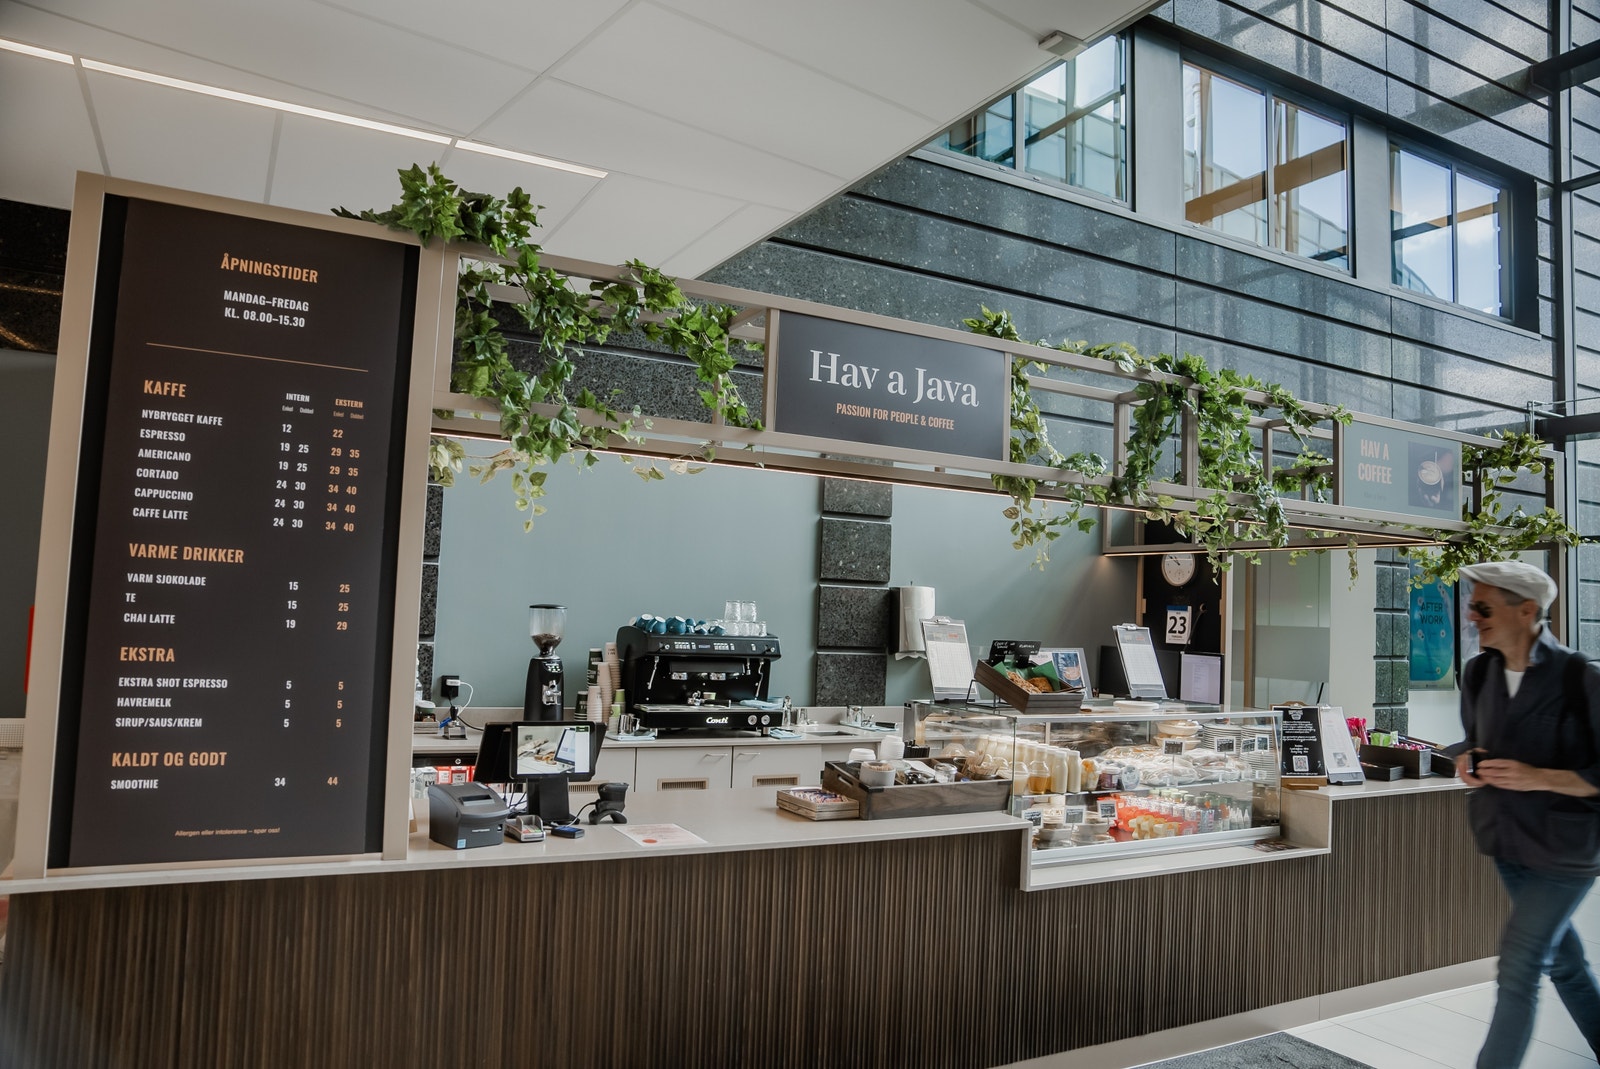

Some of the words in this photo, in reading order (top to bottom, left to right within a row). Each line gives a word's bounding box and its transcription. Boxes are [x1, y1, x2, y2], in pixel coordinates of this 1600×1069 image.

[221, 253, 318, 283] ÅPNINGSTIDER
[225, 307, 239, 318] KL.
[809, 350, 879, 389] Hav
[888, 371, 907, 395] a
[913, 368, 979, 407] Java
[144, 380, 186, 397] KAFFE
[286, 393, 309, 402] INTERN
[336, 399, 363, 408] EKSTERN
[142, 409, 194, 422] NYBRYGGET
[197, 415, 222, 426] KAFFE
[282, 424, 292, 433] 12
[333, 429, 343, 438] 22
[837, 403, 870, 417] PASSION
[873, 408, 888, 420] FOR
[891, 411, 919, 424] PEOPLE
[921, 416, 926, 425] &
[929, 417, 954, 430] COFFEE
[140, 429, 185, 441] ESPRESSO
[281, 443, 290, 451] 19
[299, 444, 309, 453] 25
[331, 448, 341, 456] 29
[350, 449, 359, 458] 35
[1361, 439, 1380, 458] HAV
[1382, 443, 1389, 460] A
[138, 449, 191, 461] AMERICANO
[279, 461, 288, 470] 19
[297, 463, 307, 472] 25
[330, 466, 340, 474] 29
[348, 468, 358, 476] 35
[137, 468, 178, 480] CORTADO
[277, 480, 287, 488] 24
[295, 482, 306, 490] 30
[328, 485, 338, 493] 34
[346, 486, 356, 494] 40
[1358, 463, 1392, 484] COFFEE
[135, 488, 193, 500] CAPPUCCINO
[275, 499, 285, 507] 24
[294, 500, 304, 509] 30
[327, 503, 337, 511] 34
[345, 505, 355, 513] 40
[133, 508, 160, 518] CAFFE
[163, 510, 188, 520] LATTE
[273, 518, 284, 526] 24
[292, 519, 303, 528] 30
[326, 522, 336, 530] 34
[344, 523, 354, 531] 40
[130, 543, 178, 559] VARME
[183, 547, 244, 563] DRIKKER
[128, 573, 153, 583] VARM
[156, 575, 206, 585] SJOKOLADE
[289, 582, 298, 590] 15
[340, 584, 349, 593] 25
[126, 593, 136, 602] TE
[288, 601, 297, 609] 15
[338, 603, 348, 611] 25
[1420, 602, 1443, 612] AFTER
[124, 613, 146, 622] CHAI
[150, 614, 175, 624] LATTE
[286, 620, 295, 628] 19
[337, 622, 347, 630] 29
[1168, 616, 1187, 634] 23
[1420, 614, 1444, 624] WORK
[120, 647, 174, 662] EKSTRA
[119, 677, 153, 687] EKSTRA
[157, 678, 180, 687] SHOT
[183, 679, 227, 688] ESPRESSO
[286, 681, 291, 689] 5
[339, 682, 343, 690] 5
[117, 698, 171, 707] HAVREMELK
[285, 700, 290, 708] 5
[337, 700, 342, 709] 5
[116, 718, 202, 727] SIRUP/SAUS/KREM
[284, 719, 289, 727] 5
[336, 719, 341, 727] 5
[112, 753, 159, 766] KALDT
[164, 752, 183, 766] OG
[189, 752, 227, 766] GODT
[111, 779, 158, 789] SMOOTHIE
[275, 778, 285, 786] 34
[328, 777, 338, 785] 44
